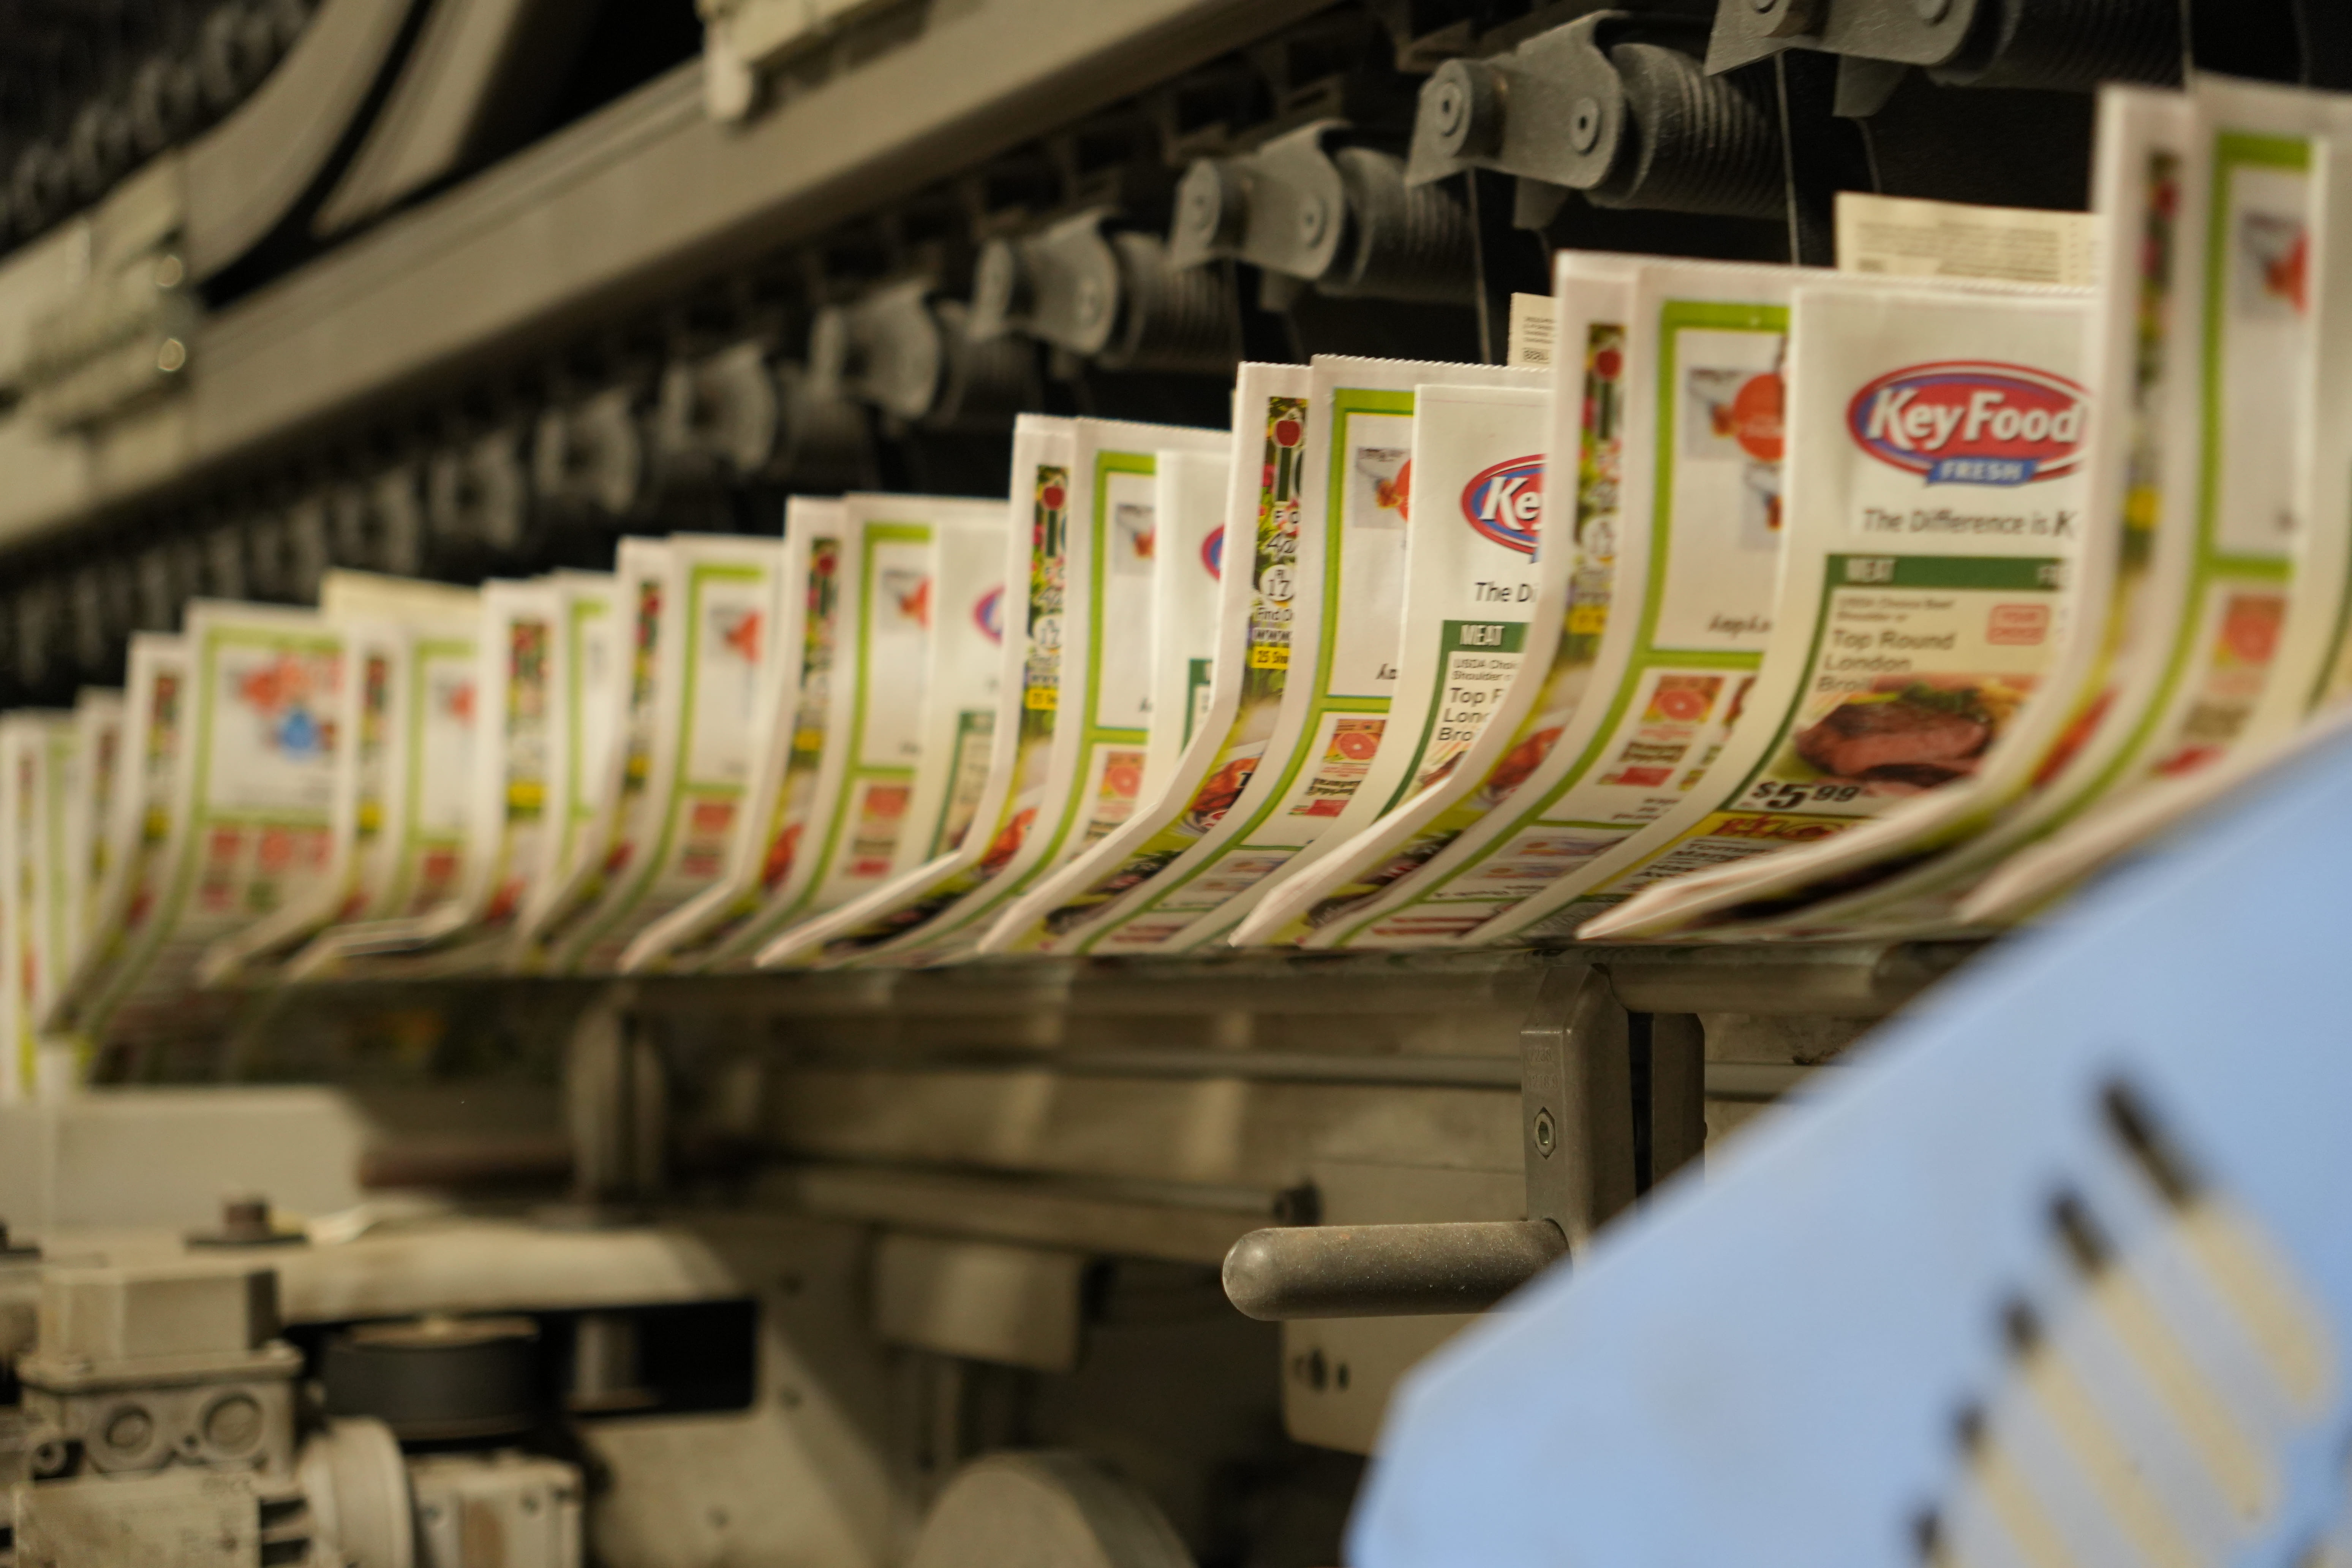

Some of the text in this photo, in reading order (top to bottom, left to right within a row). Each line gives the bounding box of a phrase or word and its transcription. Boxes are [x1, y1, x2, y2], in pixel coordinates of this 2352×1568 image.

[1865, 386, 1964, 450] Key
[1940, 461, 2023, 481] FRESH
[1477, 476, 1544, 531] Ke
[1863, 508, 1903, 533] The
[1909, 508, 2024, 534] Difference
[1267, 579, 1290, 597] 17
[1474, 581, 1513, 602] The
[1459, 624, 1505, 646] MEAT
[1880, 629, 1956, 650] Round
[1825, 653, 1913, 672] London
[1452, 670, 1503, 681] Shoulder
[1450, 687, 1486, 707] Top
